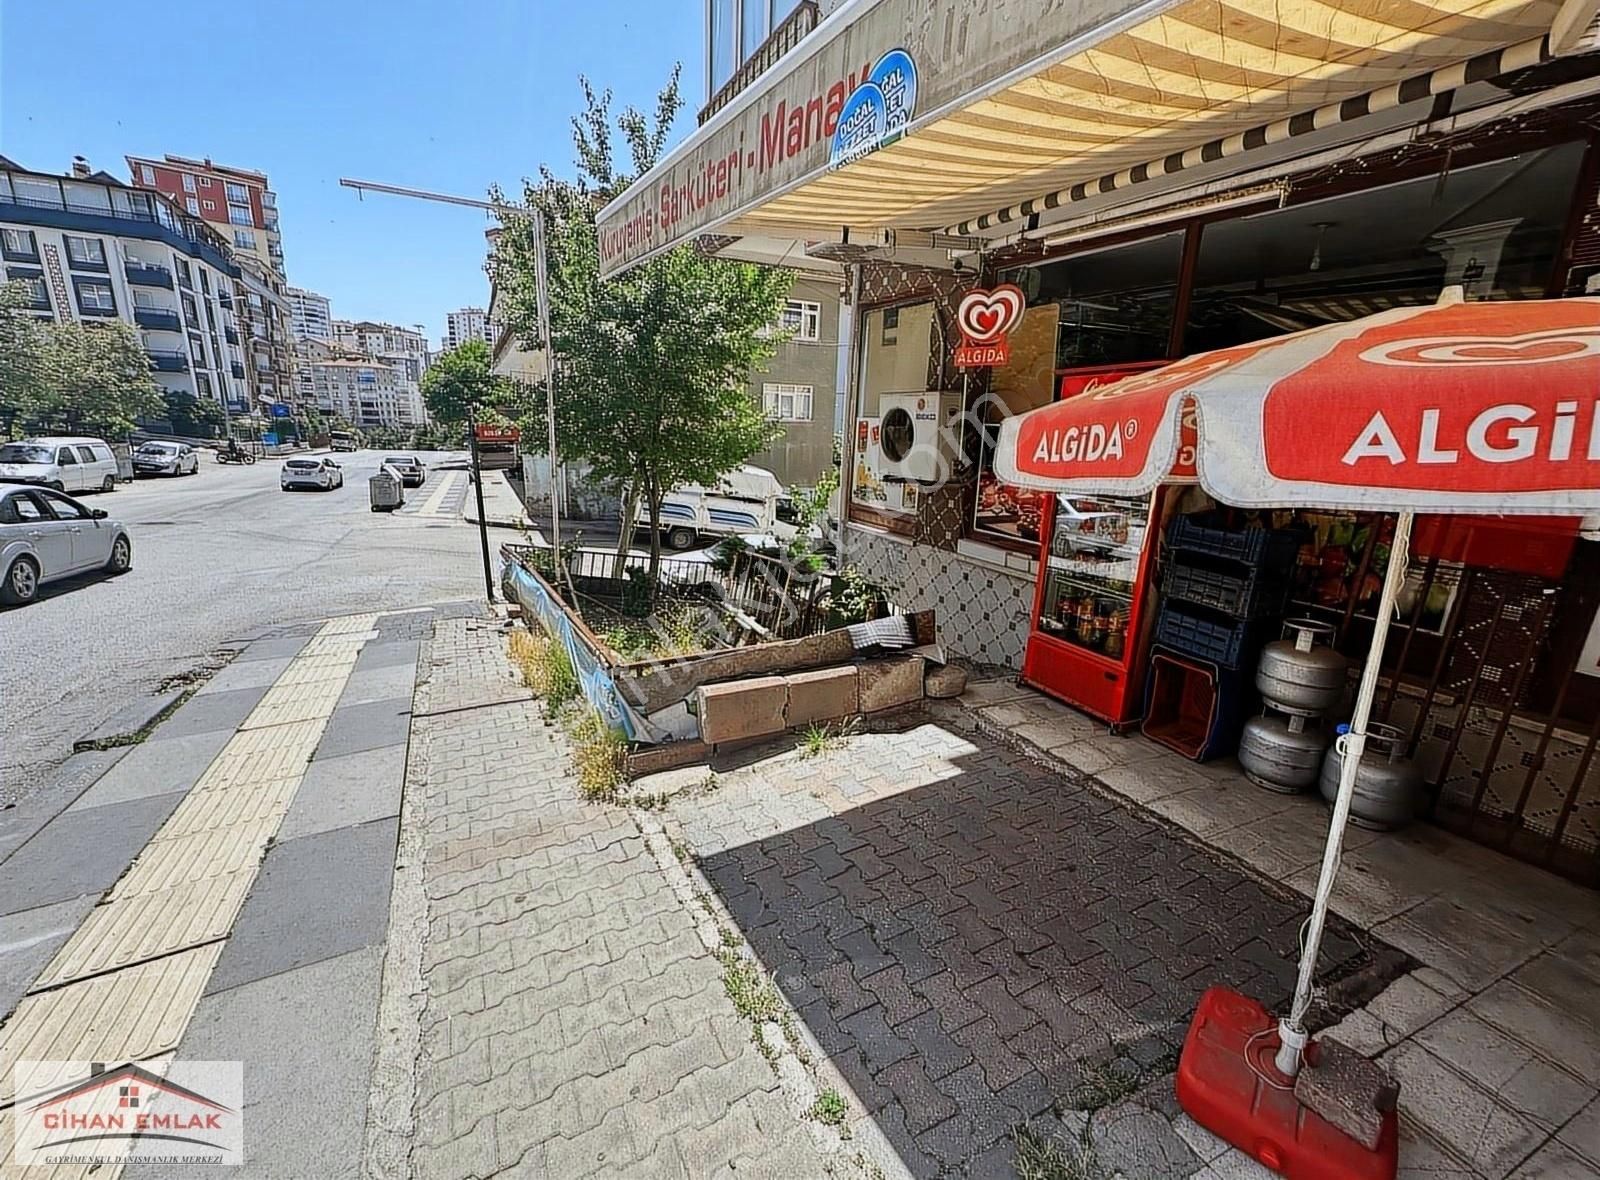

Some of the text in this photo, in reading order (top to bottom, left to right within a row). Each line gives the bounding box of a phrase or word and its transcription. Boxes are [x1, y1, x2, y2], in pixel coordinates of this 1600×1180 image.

[840, 98, 875, 139] DOĞAL
[600, 200, 653, 263] Kuruyemiş
[660, 130, 743, 242] Şarküteri
